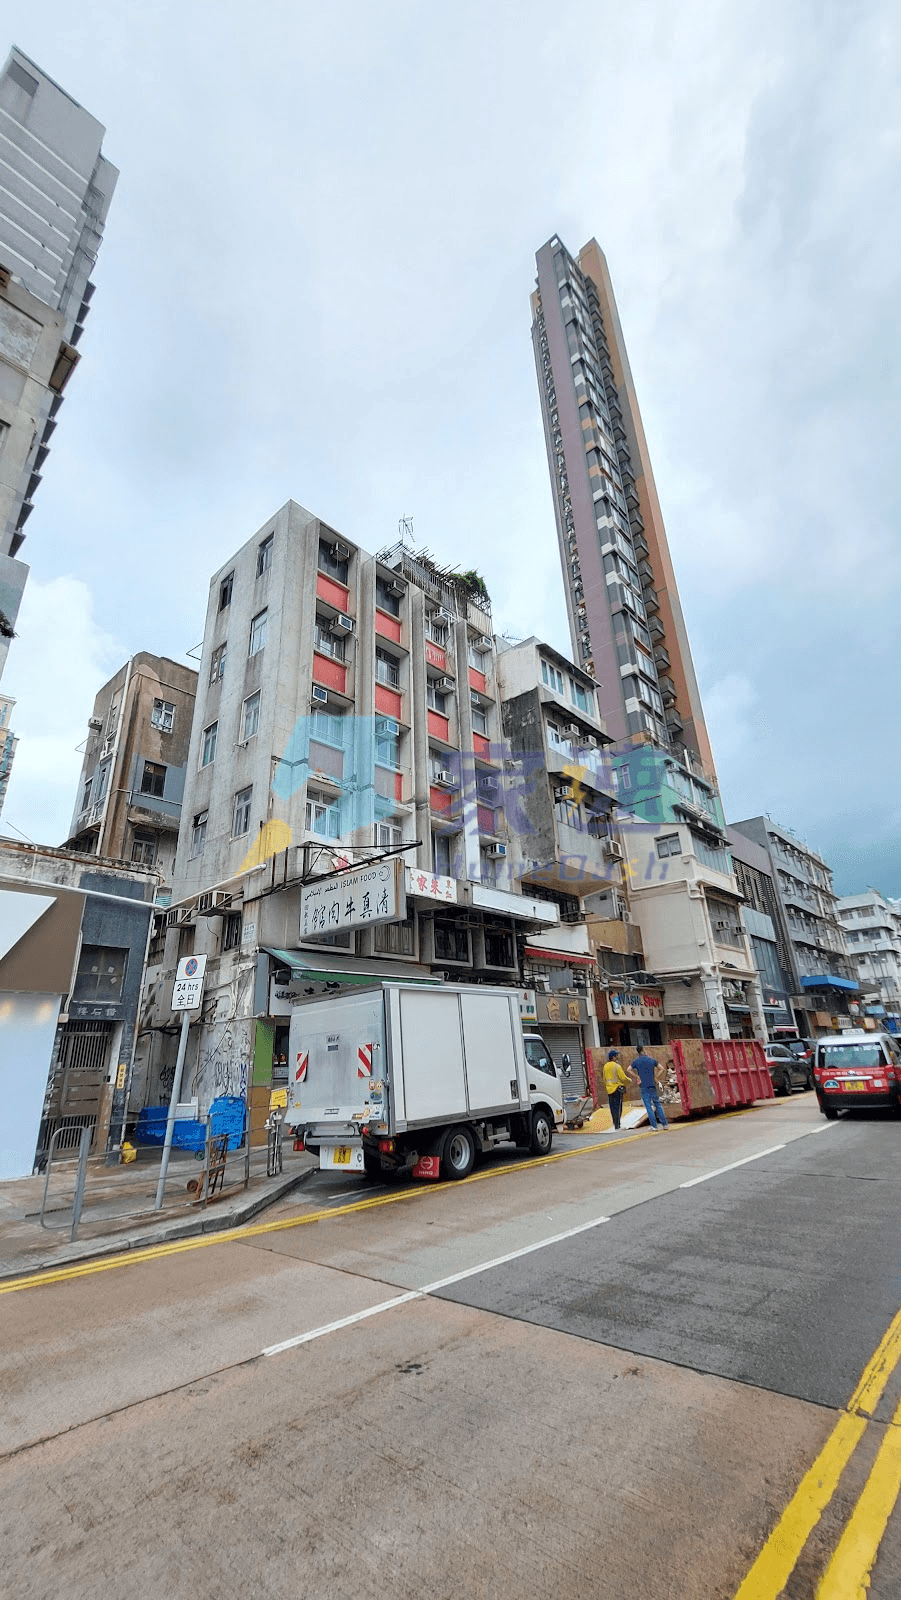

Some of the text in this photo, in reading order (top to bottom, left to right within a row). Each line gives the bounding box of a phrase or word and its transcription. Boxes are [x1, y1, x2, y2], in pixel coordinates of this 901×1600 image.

[340, 871, 377, 888] ISLAM FOOD
[176, 982, 199, 992] 24 hrs
[176, 994, 195, 1007] 全日
